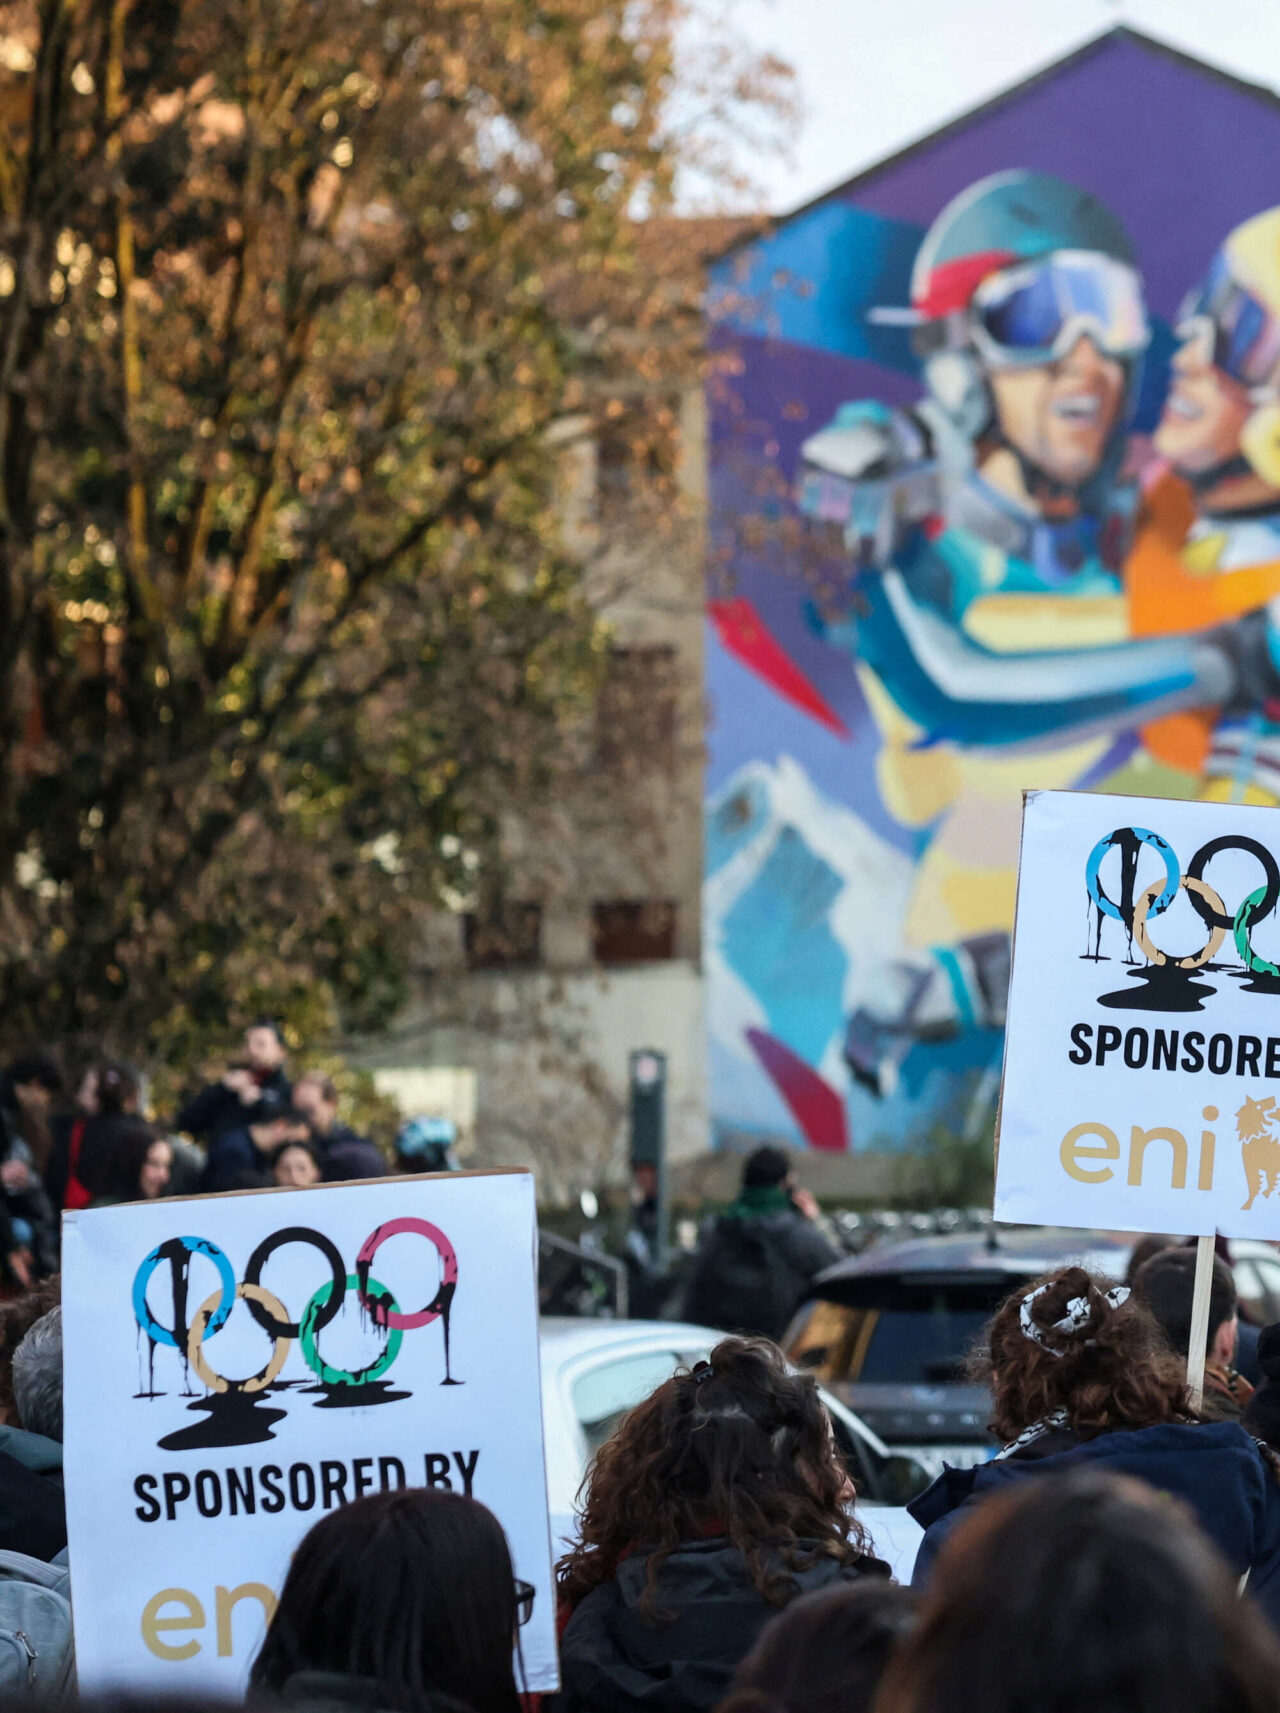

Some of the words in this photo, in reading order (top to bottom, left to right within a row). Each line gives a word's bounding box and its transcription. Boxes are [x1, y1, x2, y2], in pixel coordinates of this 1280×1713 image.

[1059, 1104, 1220, 1191] eni
[133, 1456, 406, 1523] SPONSORED
[424, 1450, 480, 1500] BY
[141, 1581, 281, 1661] en
